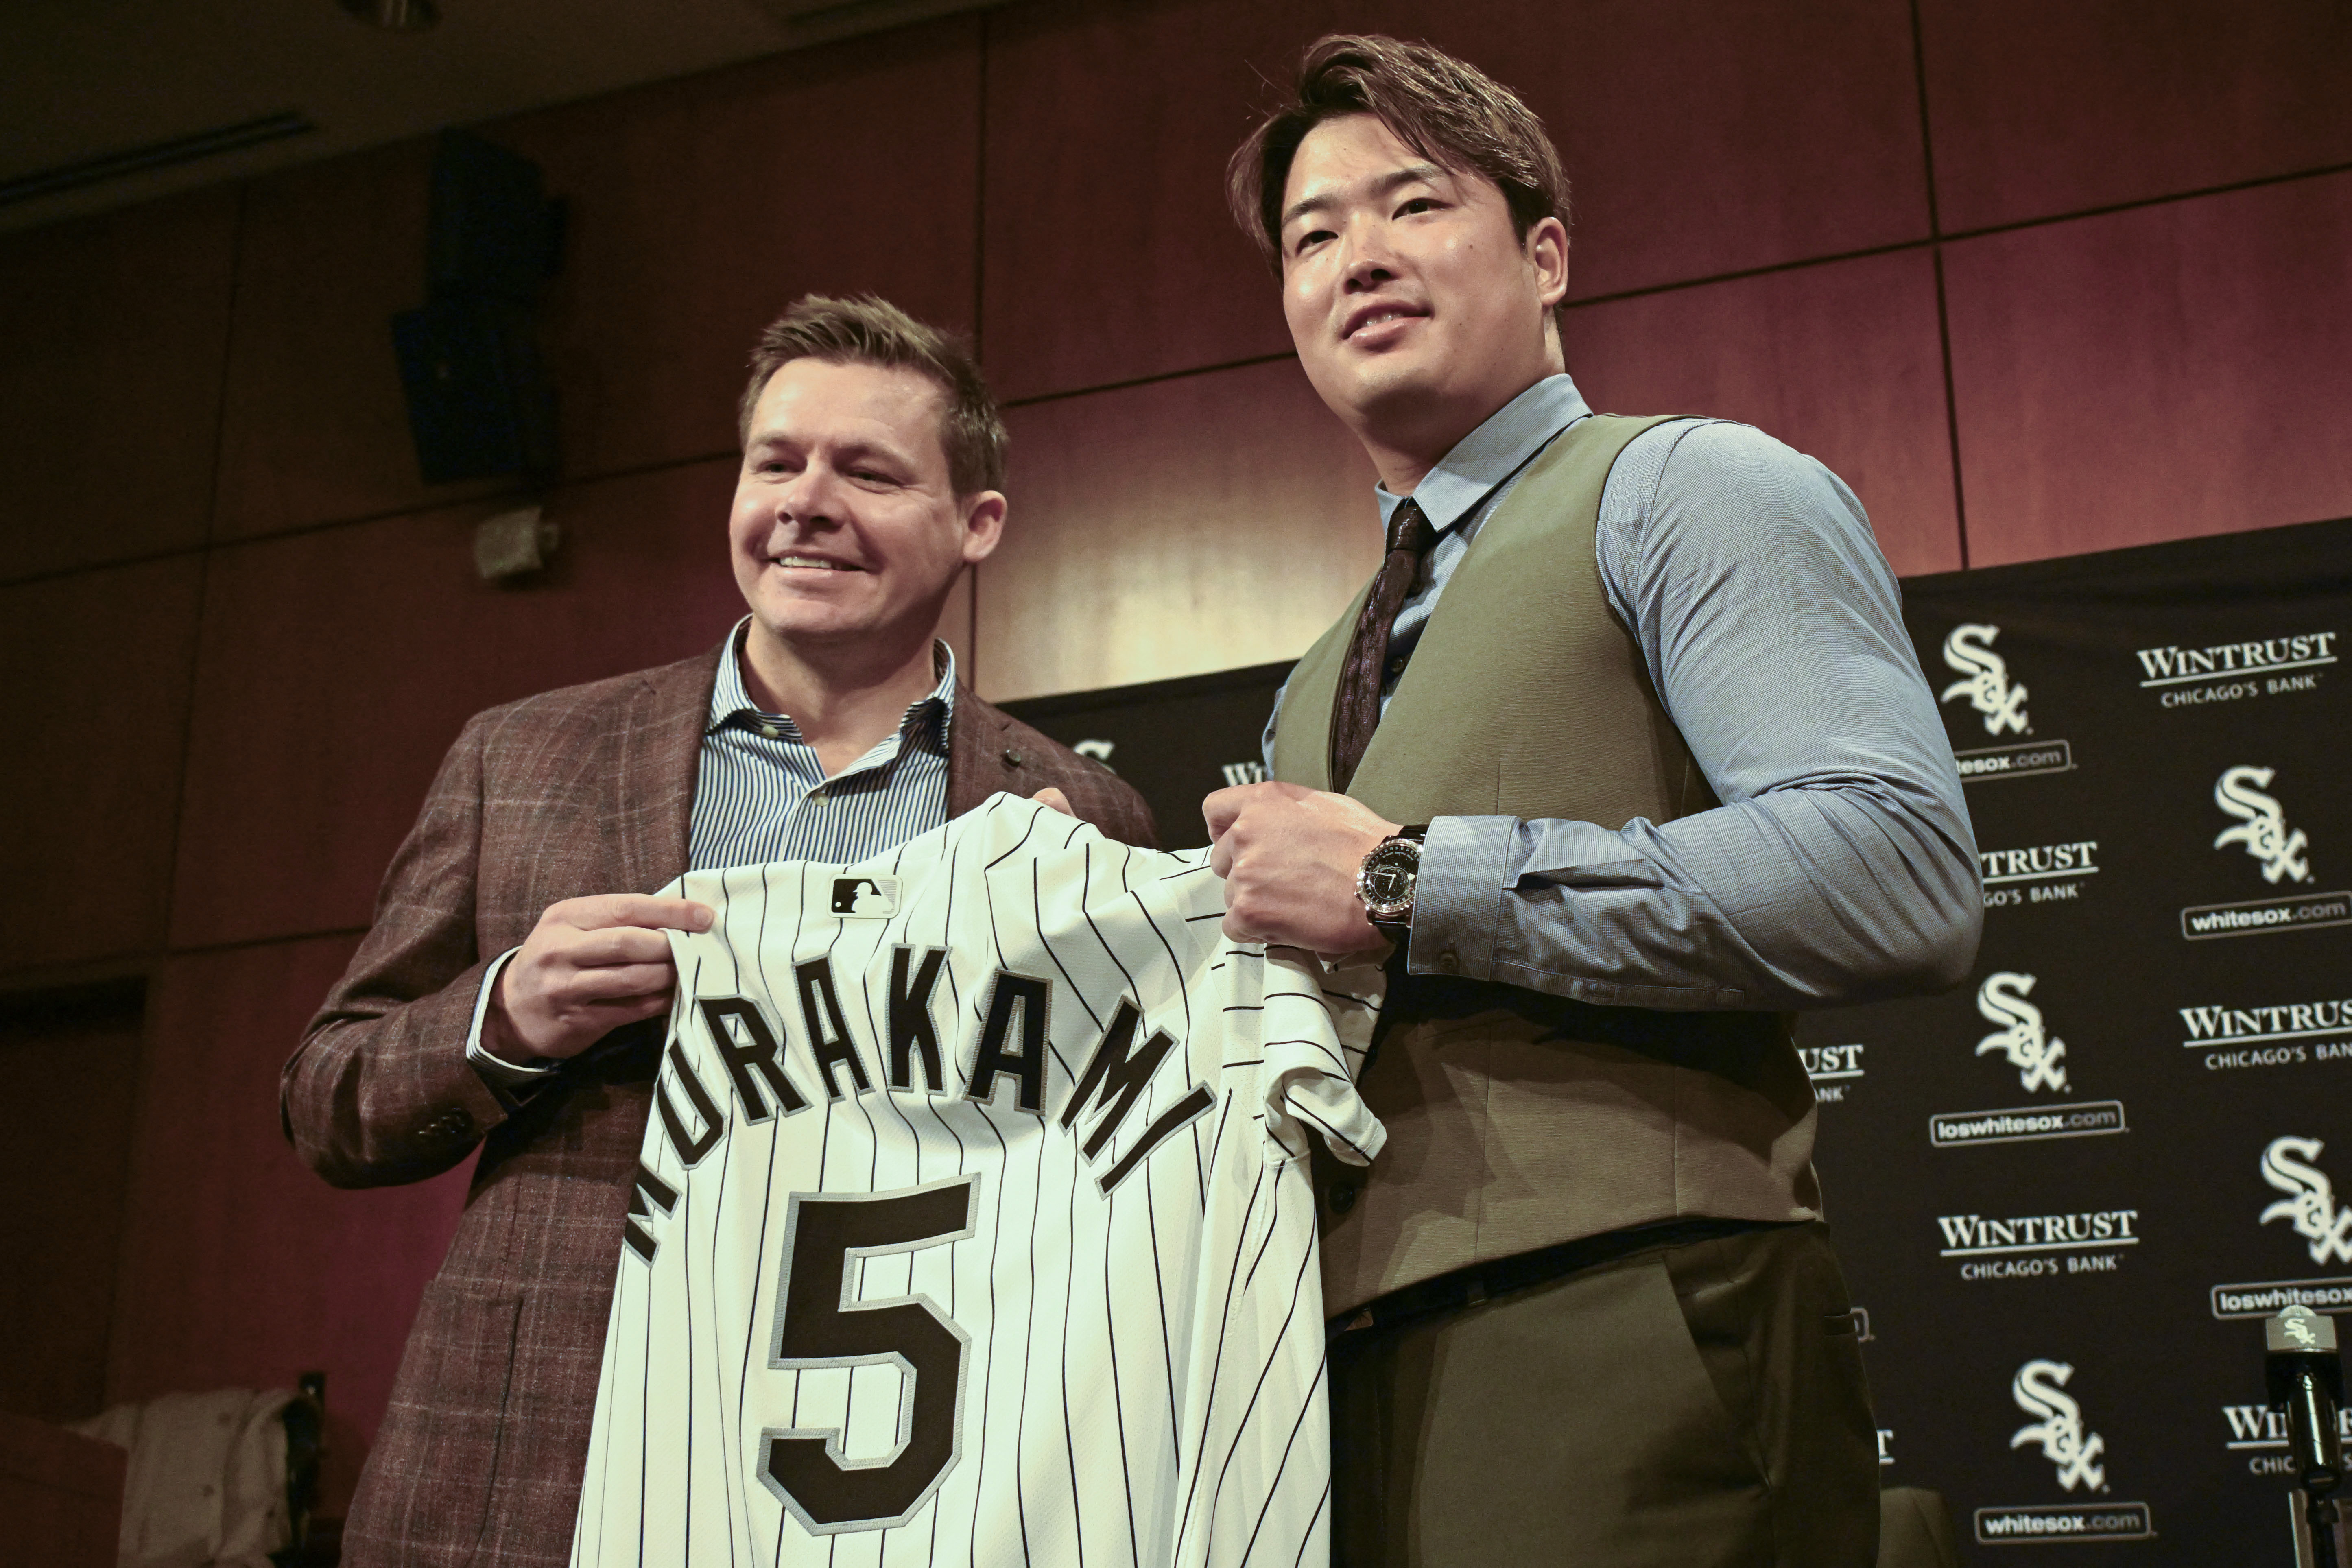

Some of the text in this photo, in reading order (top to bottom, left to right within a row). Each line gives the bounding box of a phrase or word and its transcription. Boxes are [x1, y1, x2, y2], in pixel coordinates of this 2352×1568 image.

[2137, 632, 2336, 679] WINTRUST
[2160, 675, 2317, 708] CHICAGO'S BANK
[1956, 750, 2061, 774] esox.com
[1980, 841, 2098, 876] TRUST
[2030, 884, 2078, 903] BANK
[2193, 902, 2346, 931] whitesox.com
[2179, 999, 2352, 1038] WINTRUS
[2204, 1042, 2352, 1070] CHICAGO'S BAN
[622, 943, 1218, 1269] MURAKAMI
[1938, 1111, 2116, 1139] loswhitesox.com
[1938, 1210, 2139, 1248] WINTRUST
[1961, 1255, 2117, 1281] CHICAGO'S BANK
[2220, 1287, 2352, 1310] loswhitesox
[756, 1172, 982, 1536] 5
[1985, 1514, 2141, 1535] whitesox.com
